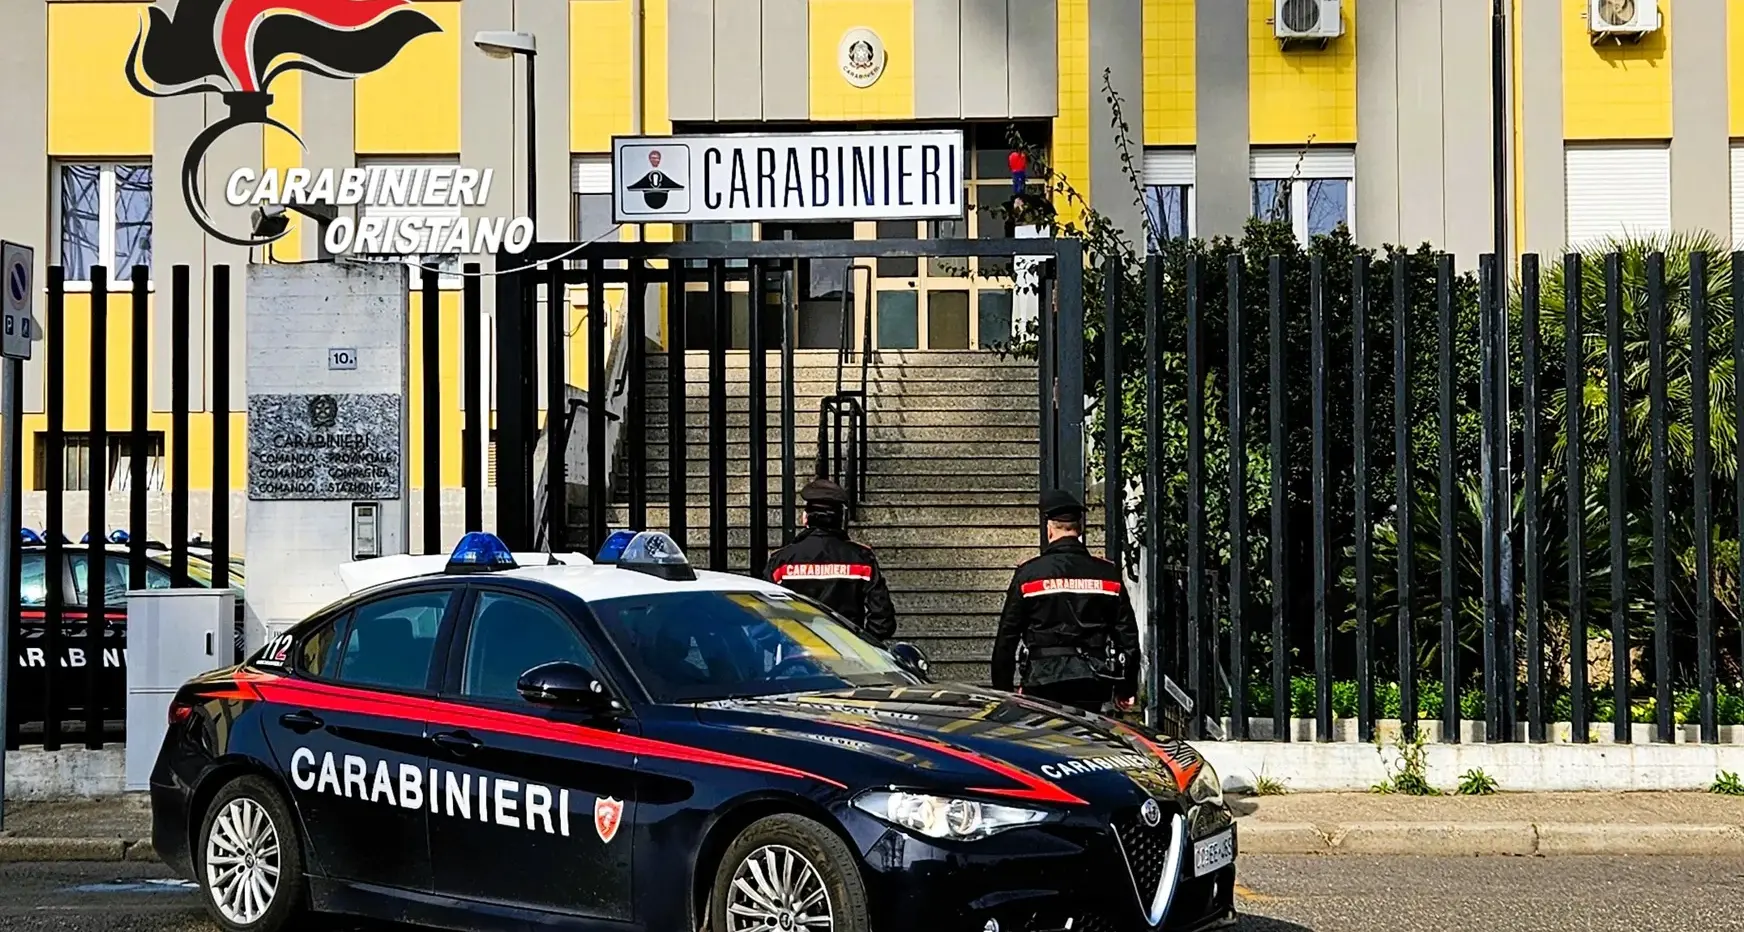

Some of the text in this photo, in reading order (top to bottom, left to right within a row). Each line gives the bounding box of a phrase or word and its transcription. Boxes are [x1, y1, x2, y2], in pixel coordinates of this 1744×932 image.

[703, 143, 956, 210] CARABINIERI
[273, 433, 370, 449] CARABINIERI
[259, 453, 316, 464] COMANDO
[259, 467, 315, 479] COMANDO
[258, 481, 381, 493] COMANDO STAZIONE
[786, 564, 850, 576] CARABINIERI
[1042, 579, 1103, 590] CARABINIERI
[261, 634, 293, 661] 112
[290, 747, 570, 837] CARABINIERI
